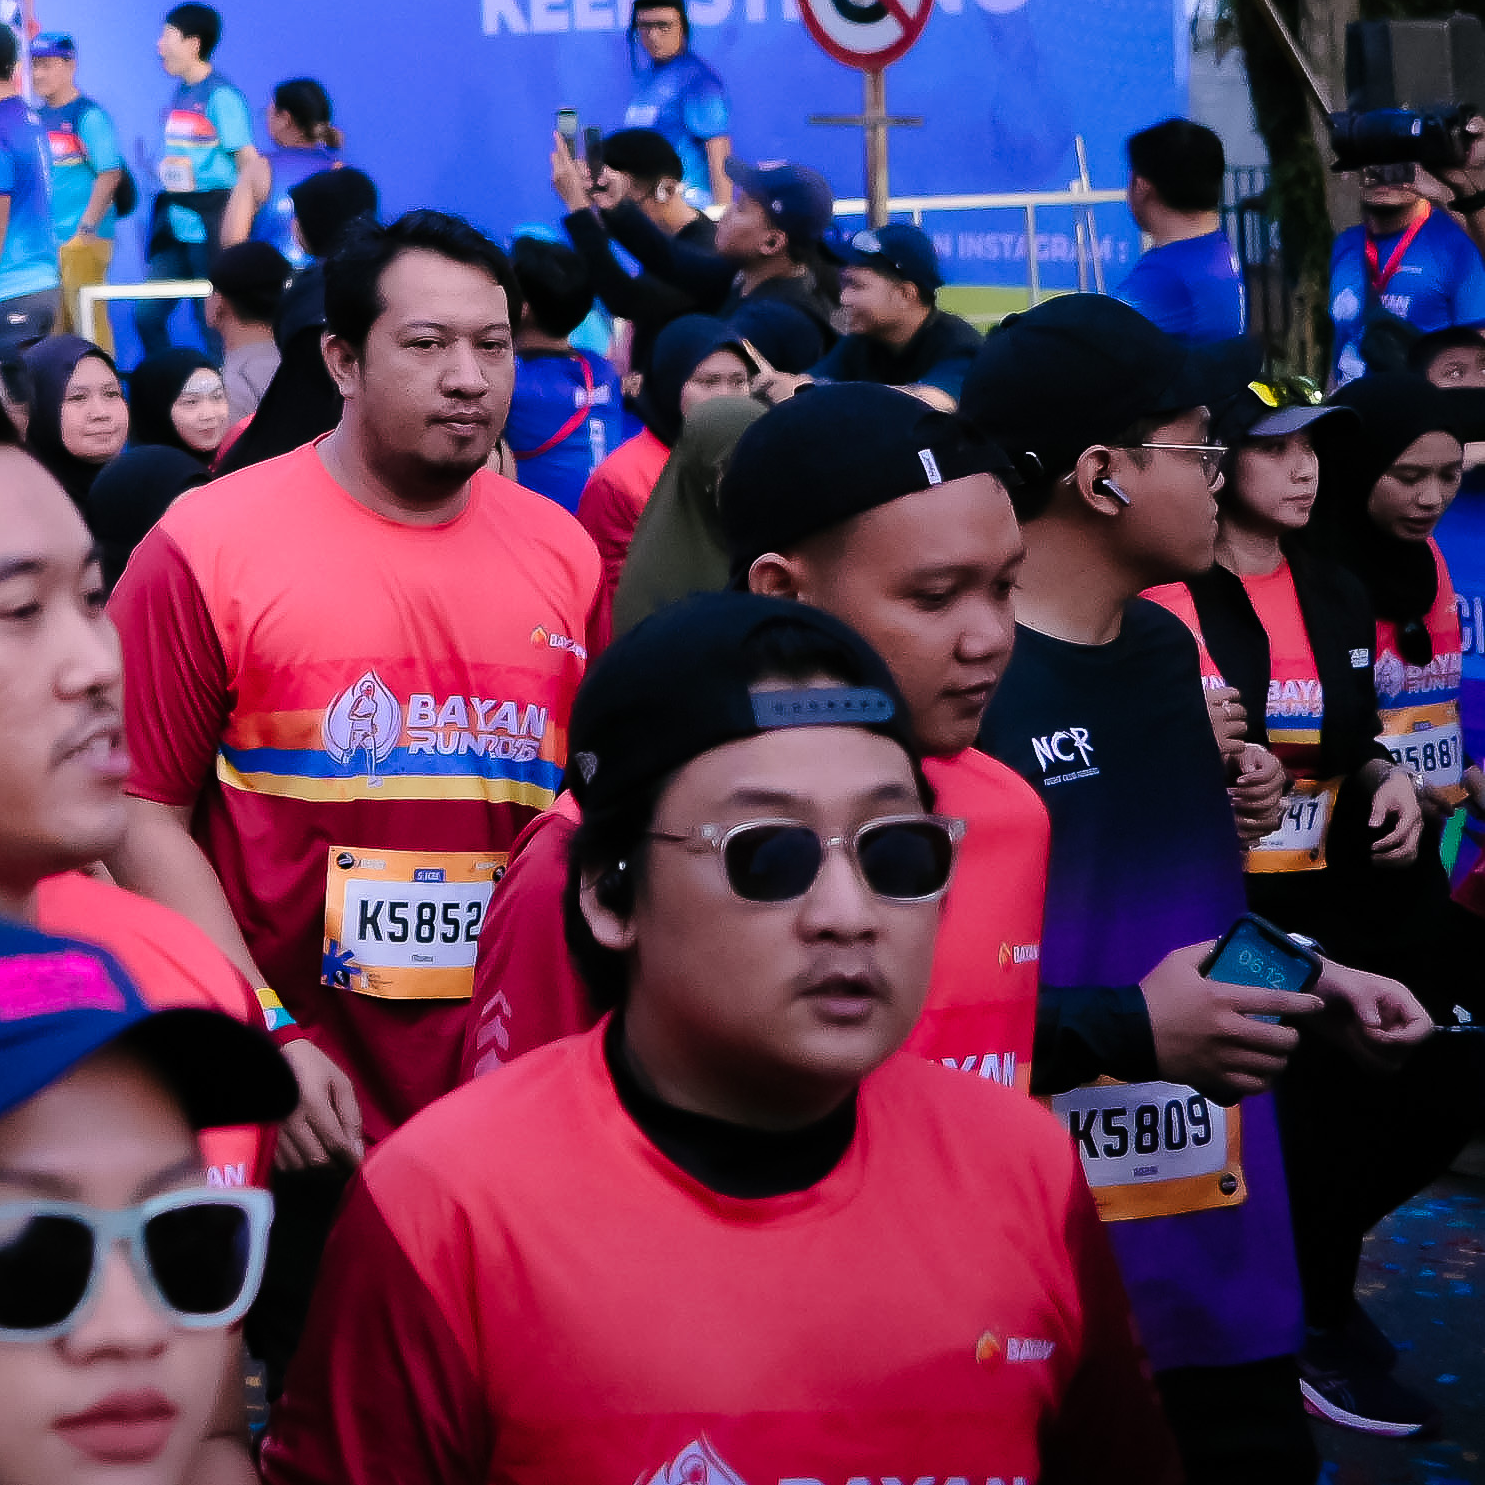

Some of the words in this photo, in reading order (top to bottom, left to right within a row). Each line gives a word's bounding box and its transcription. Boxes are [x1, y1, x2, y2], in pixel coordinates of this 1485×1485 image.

[406, 693, 549, 740] BAYAN
[407, 729, 485, 757] RUN
[1031, 726, 1094, 773] NCR
[357, 899, 483, 944] K5852
[1068, 1094, 1213, 1160] K5809
